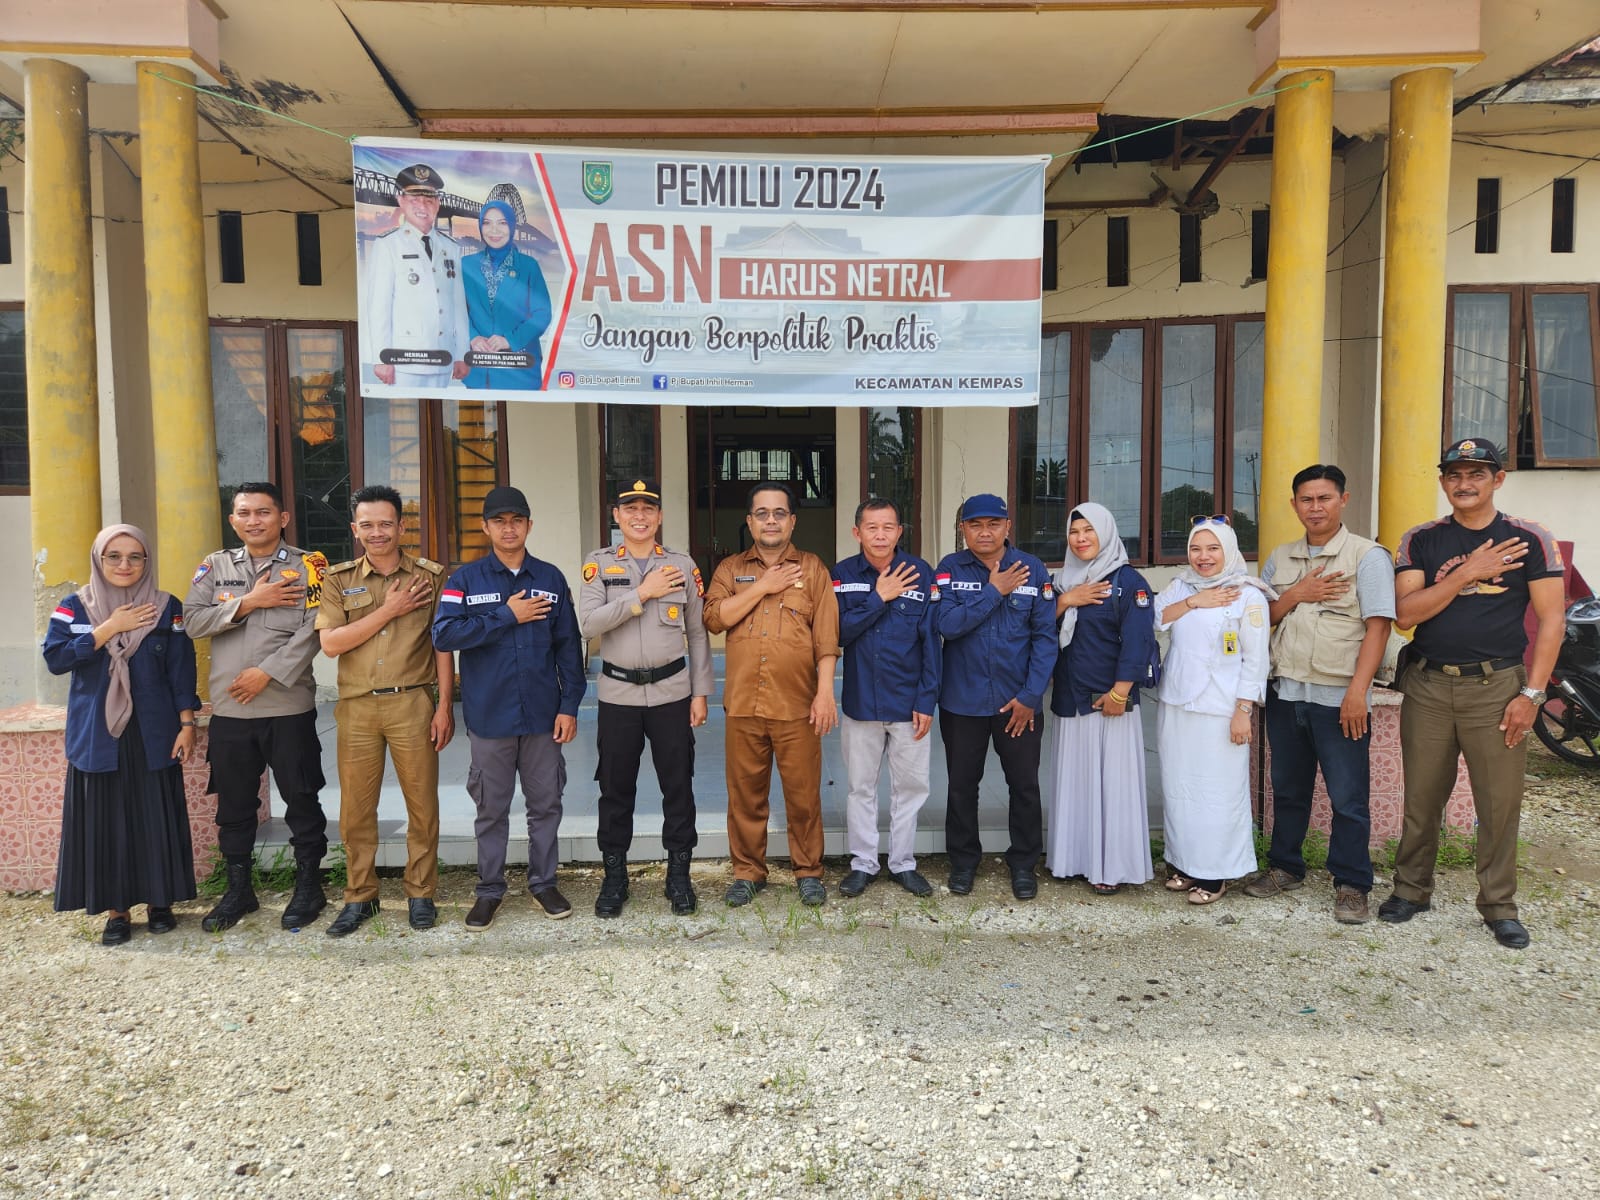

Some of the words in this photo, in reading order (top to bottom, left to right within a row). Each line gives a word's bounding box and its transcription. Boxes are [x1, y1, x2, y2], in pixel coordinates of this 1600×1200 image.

[656, 162, 781, 208] PEMILU
[793, 166, 886, 211] 2024
[581, 222, 713, 303] ASN
[740, 262, 837, 297] HARUS
[847, 262, 951, 298] NETRAL
[583, 313, 696, 364] Jangan
[703, 311, 832, 362] Berpolitik
[844, 312, 940, 353] Praktis
[680, 377, 705, 387] Bupati
[724, 379, 753, 387] Herman
[855, 377, 953, 390] KECAMATAN
[958, 377, 1024, 390] KEMPAS
